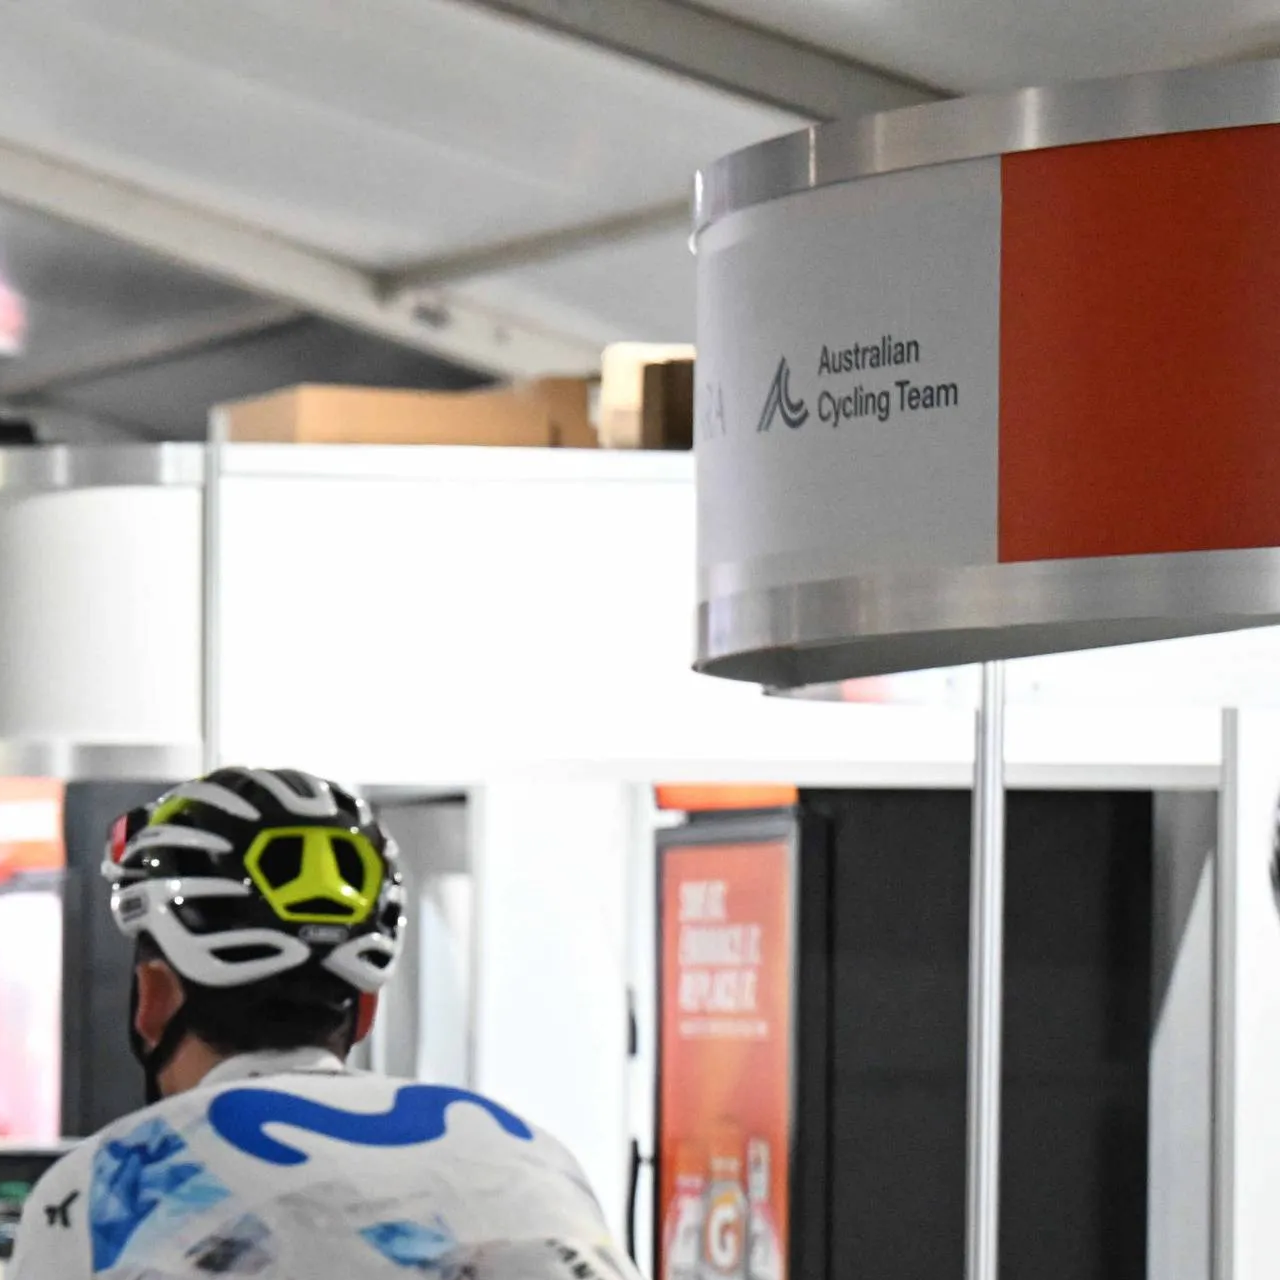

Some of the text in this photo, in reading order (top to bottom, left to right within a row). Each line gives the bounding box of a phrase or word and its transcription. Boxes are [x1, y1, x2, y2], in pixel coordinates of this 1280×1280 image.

[818, 335, 920, 376] Australian
[817, 379, 958, 428] Cycling Team
